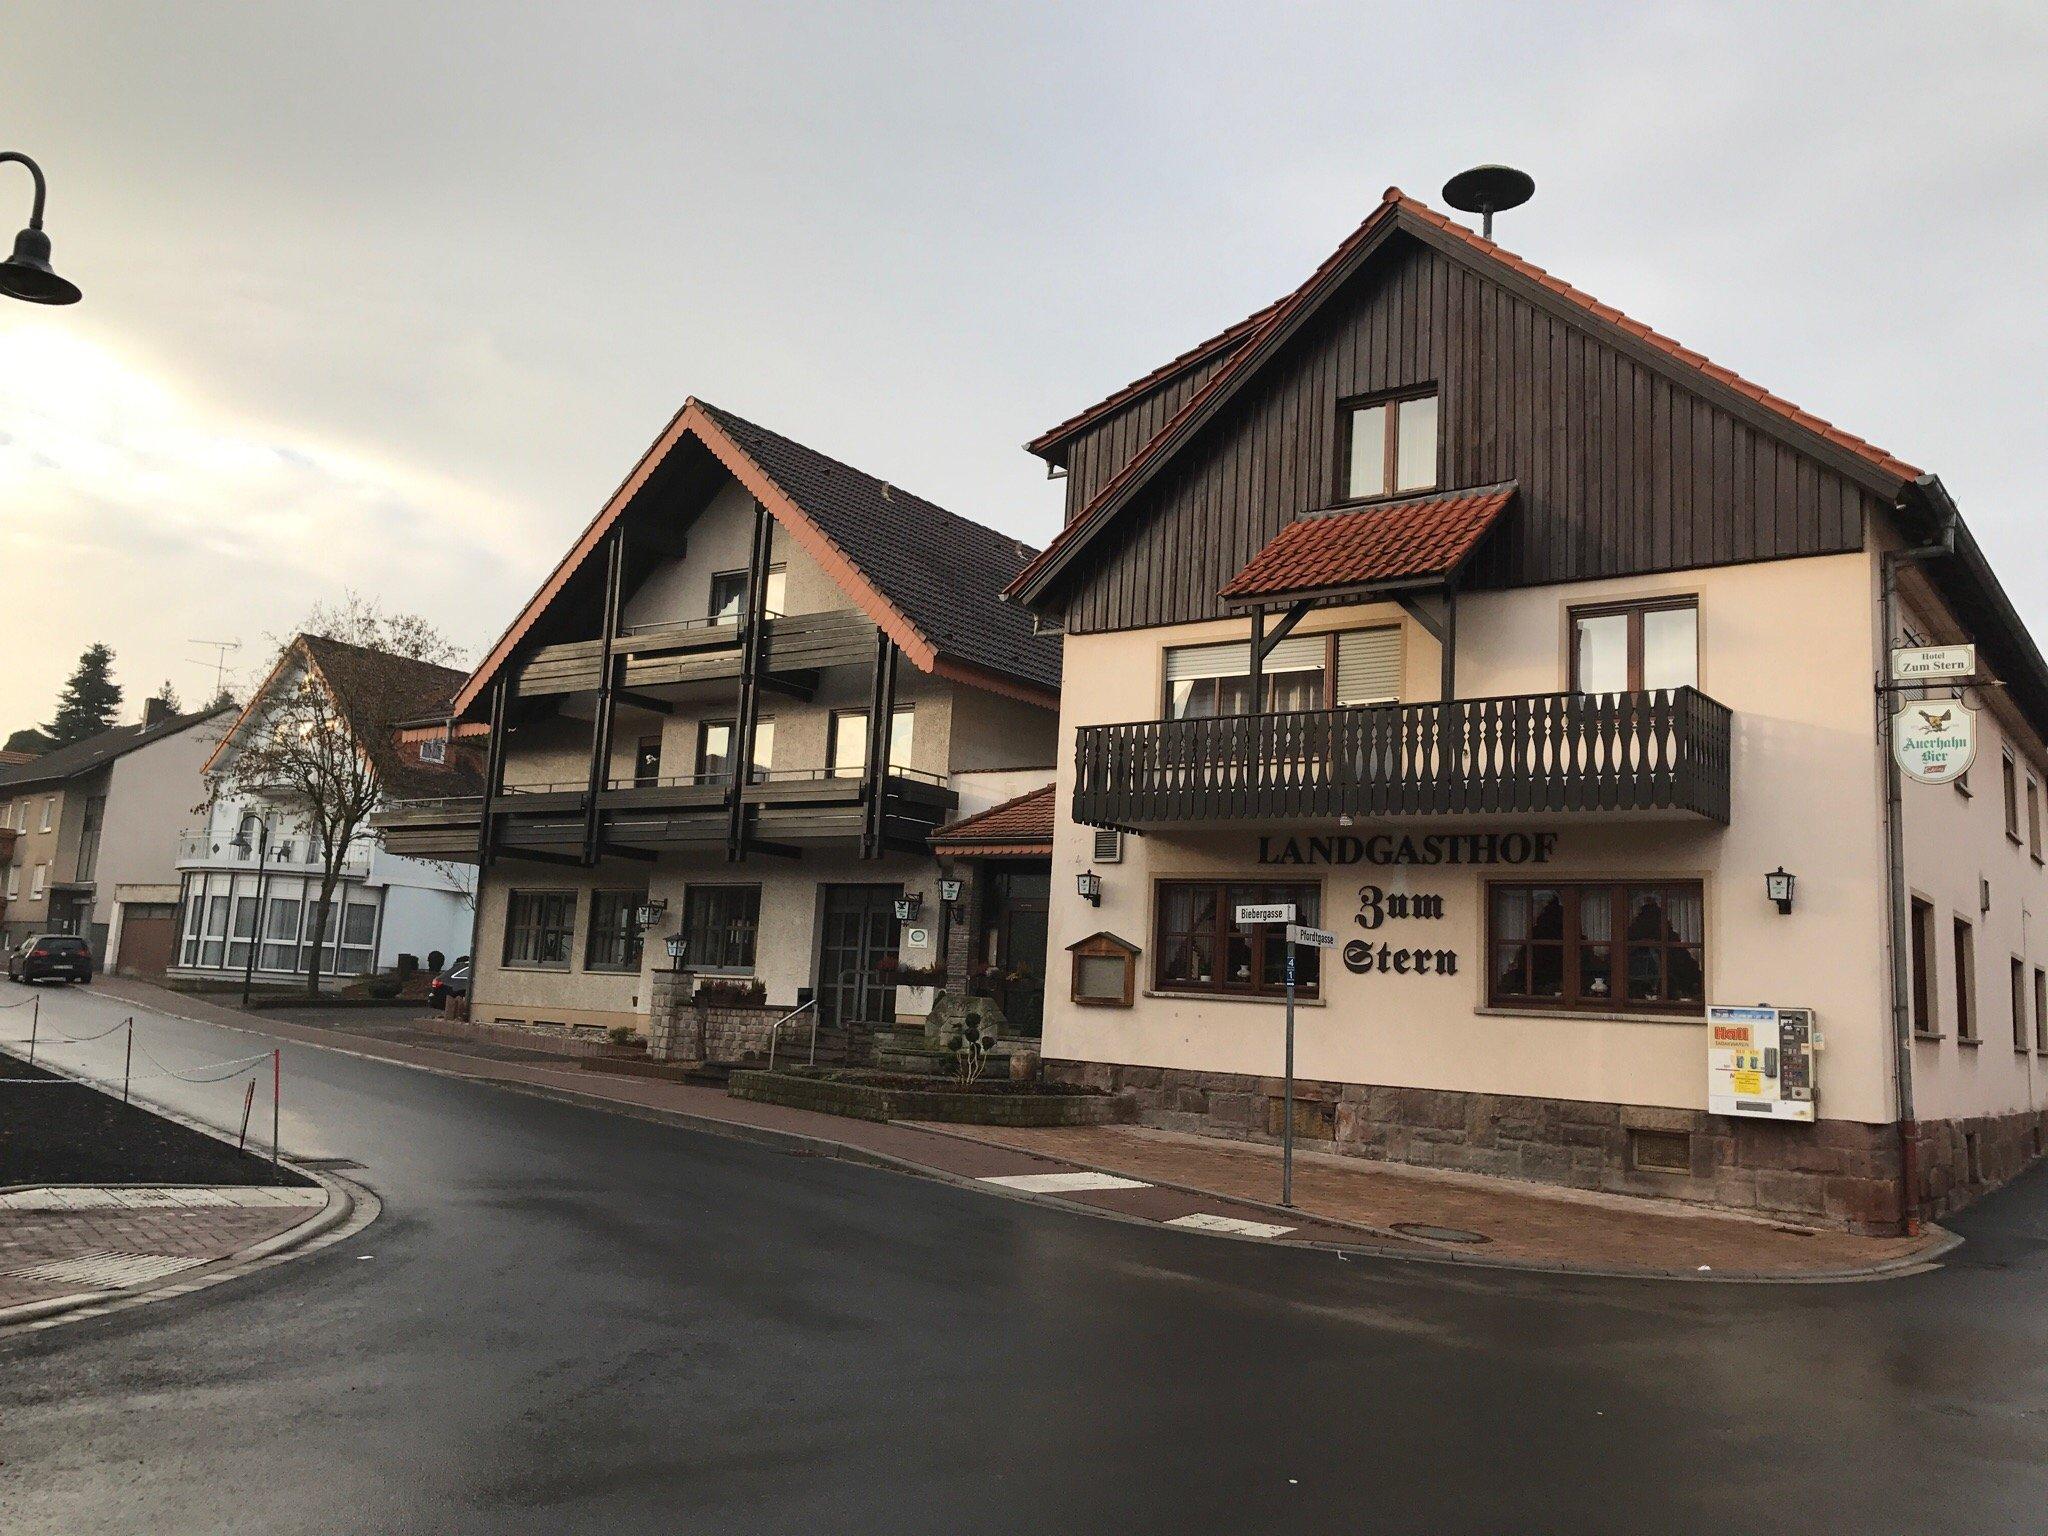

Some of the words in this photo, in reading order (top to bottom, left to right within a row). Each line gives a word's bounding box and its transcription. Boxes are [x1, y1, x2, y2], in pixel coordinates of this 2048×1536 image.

[1922, 652, 1945, 660] Hotel
[1903, 663, 1930, 672] Zum
[1933, 661, 1965, 671] Stern
[1903, 737, 1967, 751] Auerhahn
[1922, 751, 1948, 763] Bier
[1258, 832, 1557, 866] LANDGASTHOF
[1354, 885, 1444, 929] Zum
[1241, 908, 1283, 921] Biebergasse
[1300, 929, 1334, 945] Pfordtgasse
[1288, 958, 1294, 967] 4
[1343, 939, 1459, 976] Stern
